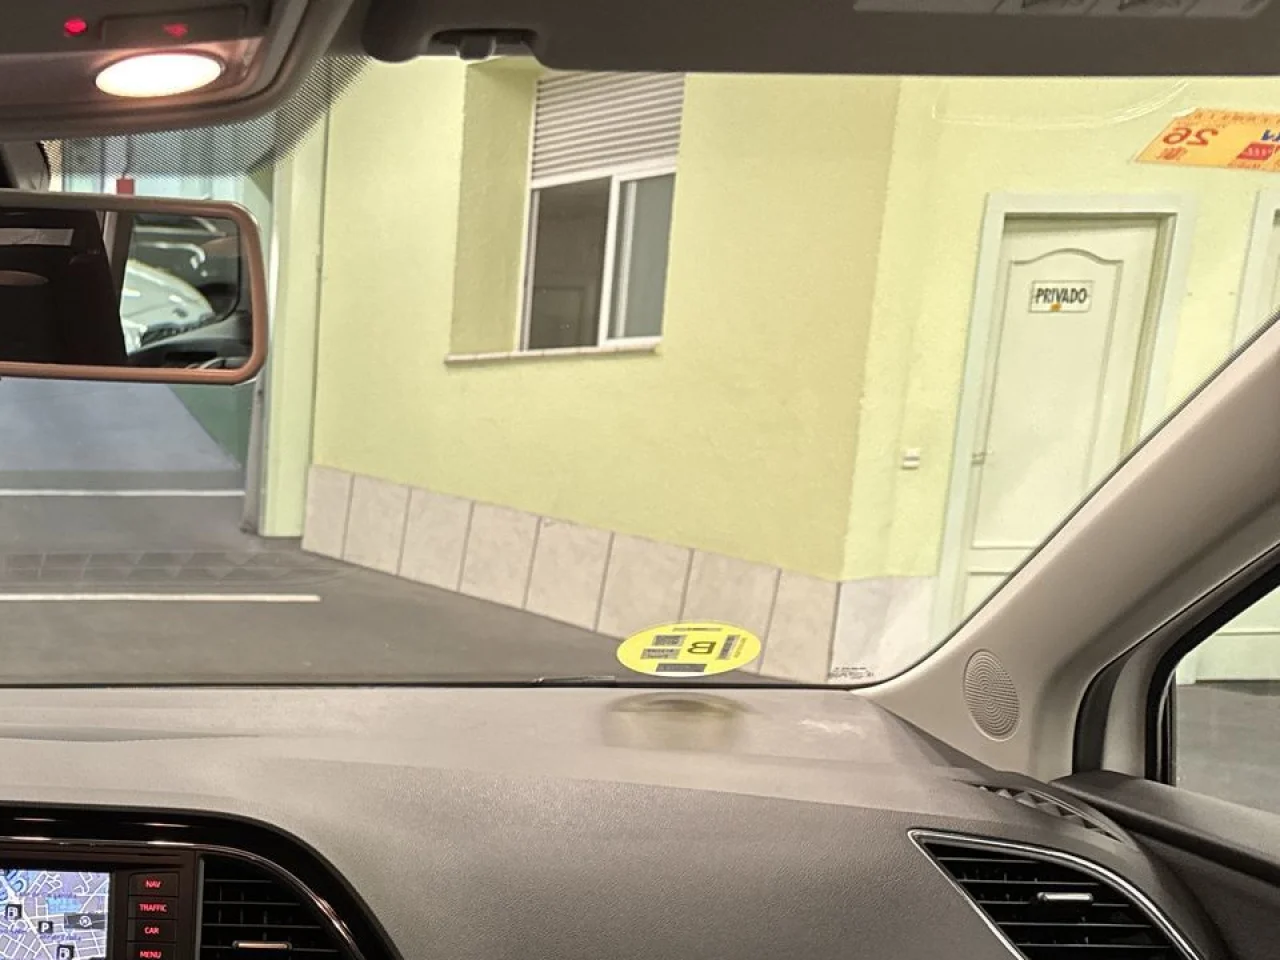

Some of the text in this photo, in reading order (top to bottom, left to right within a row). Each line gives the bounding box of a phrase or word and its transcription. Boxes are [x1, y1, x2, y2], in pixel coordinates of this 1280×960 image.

[1035, 287, 1088, 305] PRIVADO
[145, 880, 162, 889] NAV
[139, 903, 168, 912] TRAFFIC
[144, 926, 160, 935] CAR
[139, 950, 162, 960] MENU
